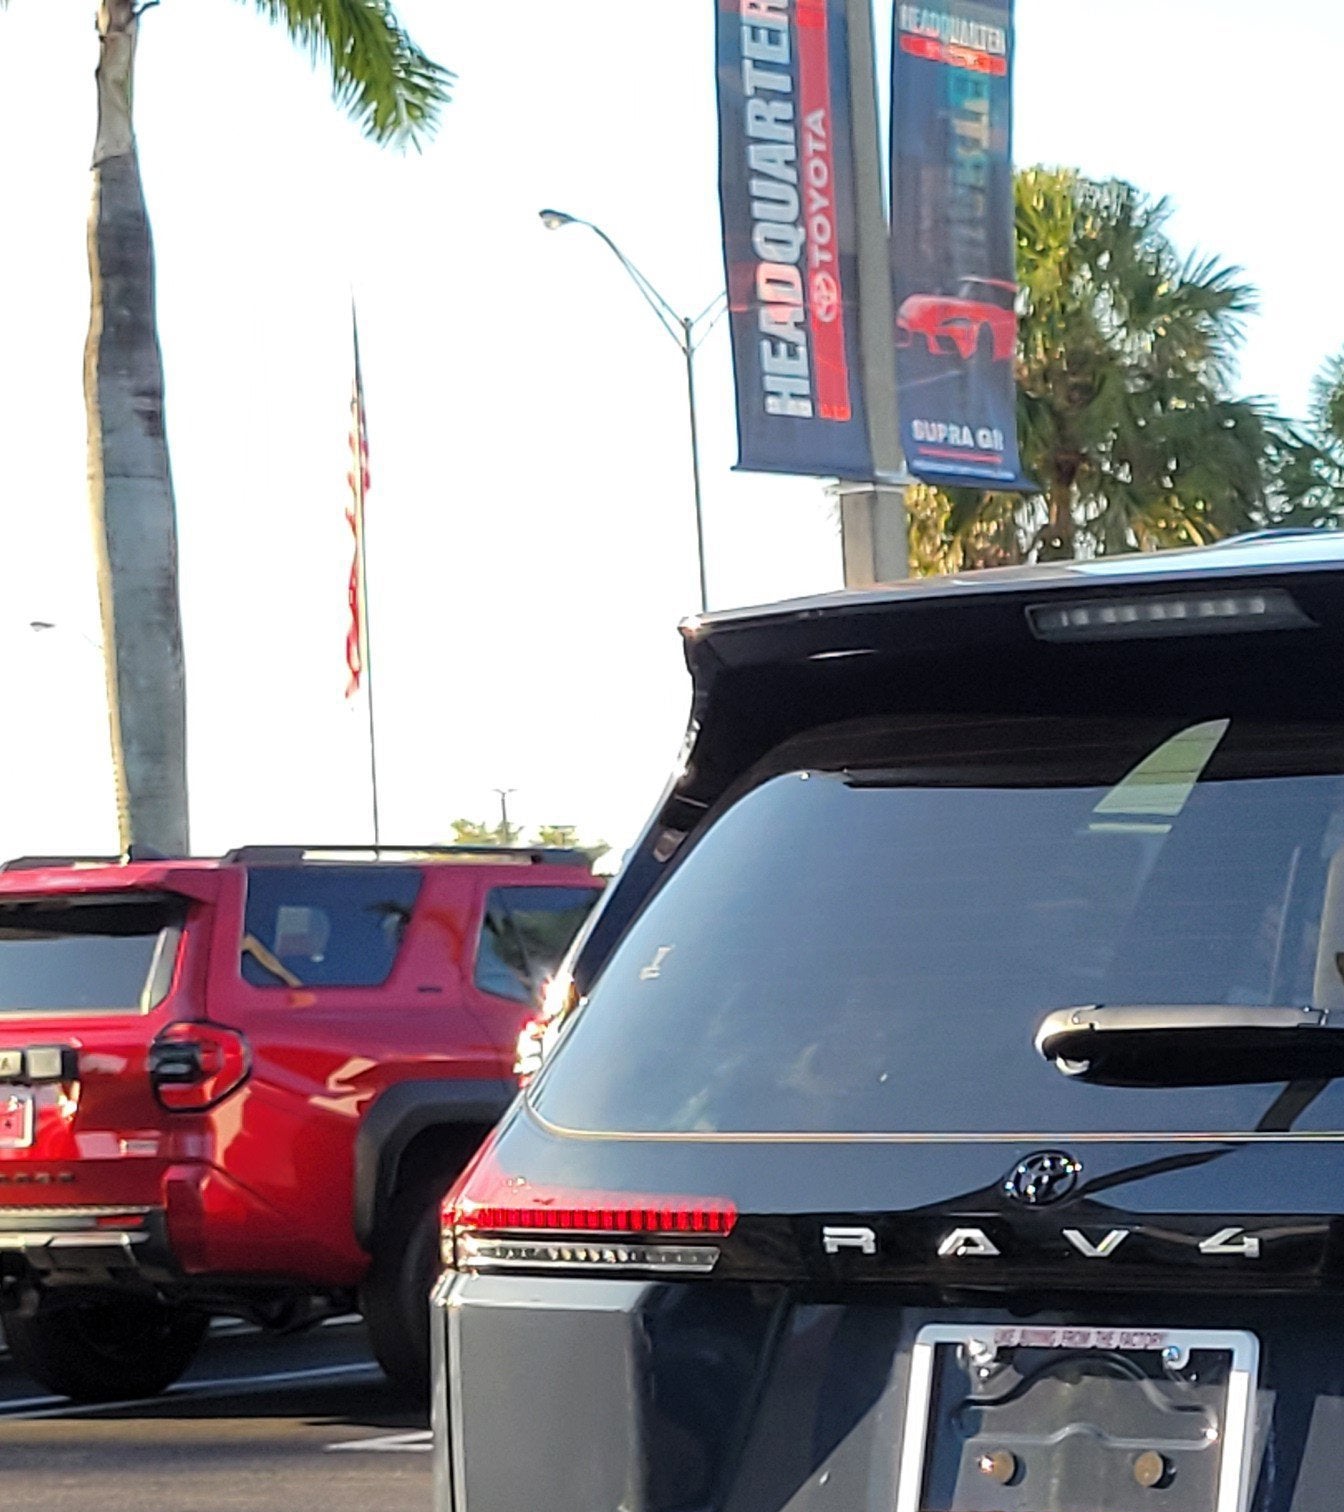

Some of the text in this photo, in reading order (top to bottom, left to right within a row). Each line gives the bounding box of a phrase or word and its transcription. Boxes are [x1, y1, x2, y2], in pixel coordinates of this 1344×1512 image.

[741, 0, 814, 419] HEADQUARTER
[805, 108, 834, 266] TOYOTA
[912, 419, 1005, 451] SUPRA GR
